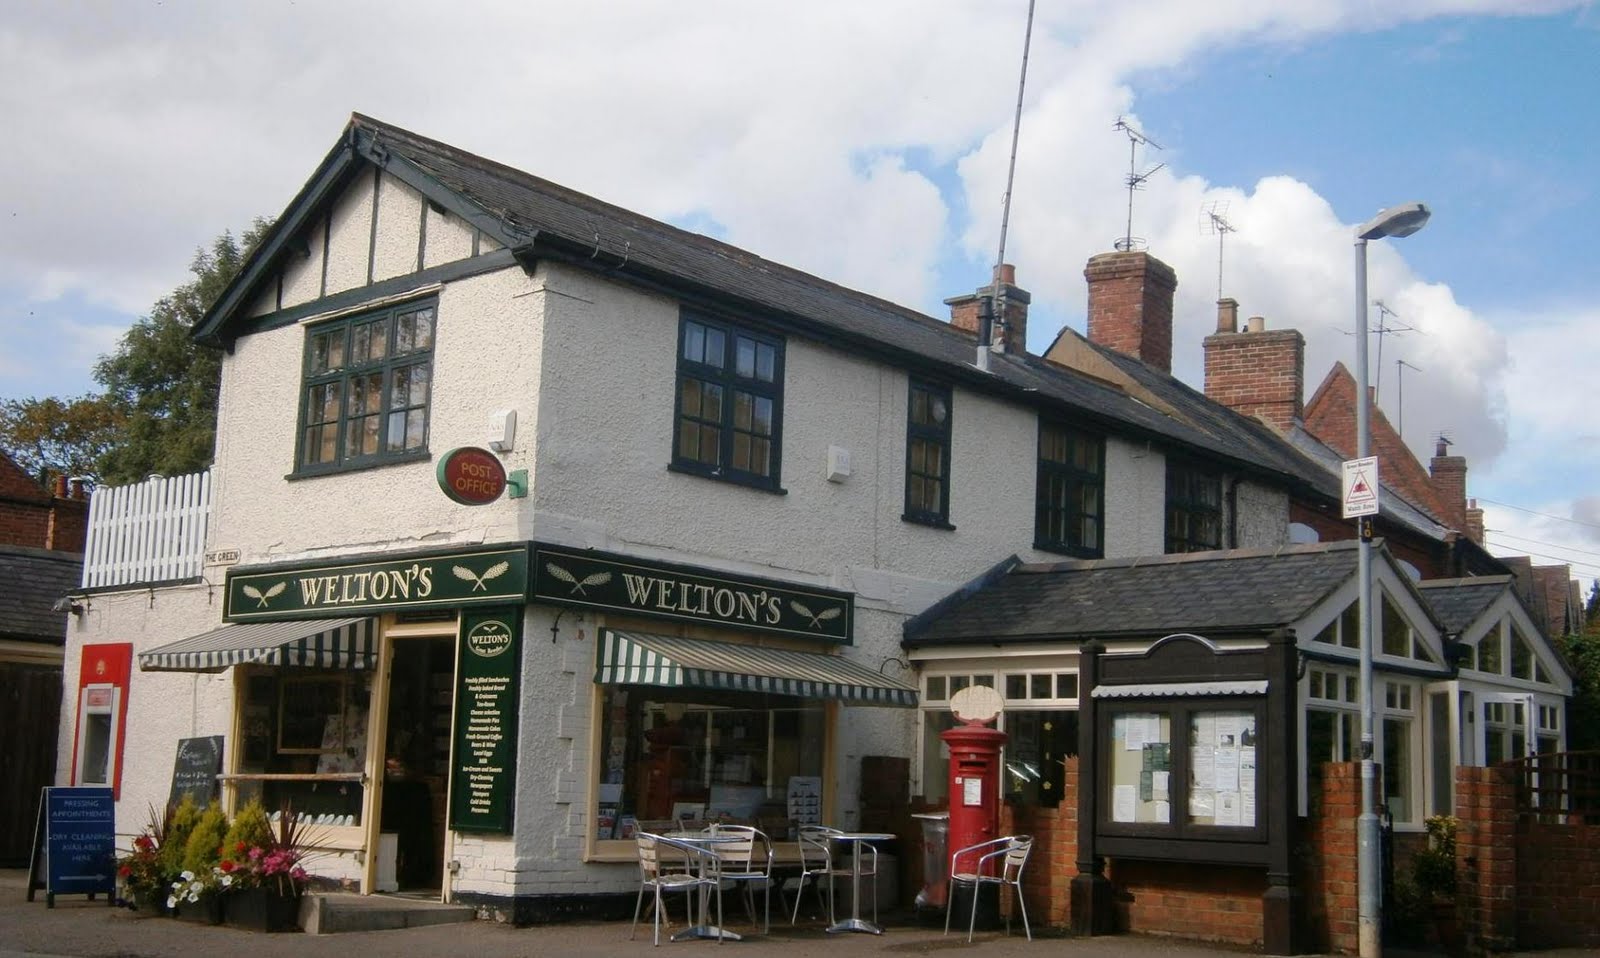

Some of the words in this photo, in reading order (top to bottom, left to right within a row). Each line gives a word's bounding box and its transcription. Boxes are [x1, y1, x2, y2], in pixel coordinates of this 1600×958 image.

[461, 462, 492, 479] POST
[456, 477, 498, 495] OFFICE
[205, 553, 216, 563] THE
[218, 551, 239, 561] GREEN
[300, 563, 433, 605] WELTON'S
[622, 573, 782, 624] WELTON'S
[472, 634, 509, 644] WELTON'S
[52, 833, 68, 841] DRY
[71, 833, 111, 841] CLEANING
